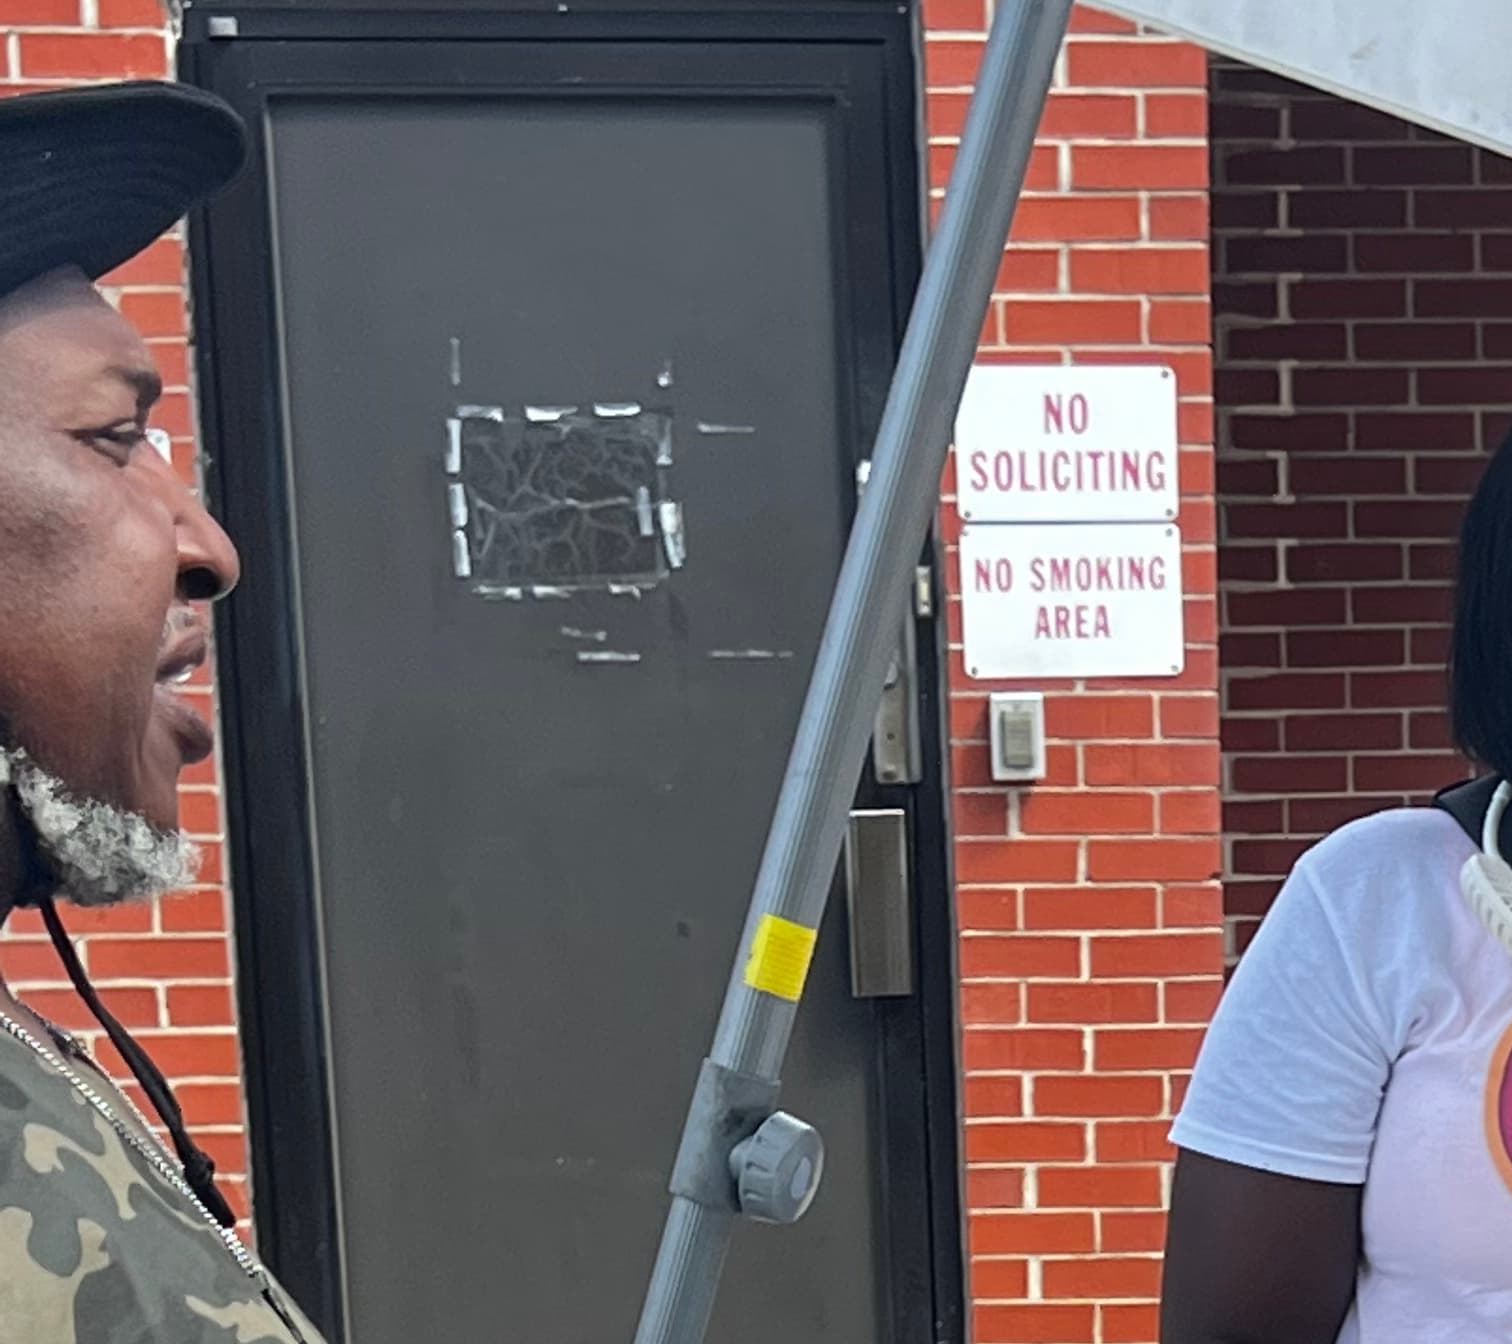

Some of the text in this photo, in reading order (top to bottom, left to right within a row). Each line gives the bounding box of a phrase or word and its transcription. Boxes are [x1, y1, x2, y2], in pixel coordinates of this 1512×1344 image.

[1043, 393, 1089, 434] NO
[970, 450, 1166, 492] SOLICITING
[974, 555, 1166, 592] NO SMOKING
[1033, 605, 1112, 639] AREA
